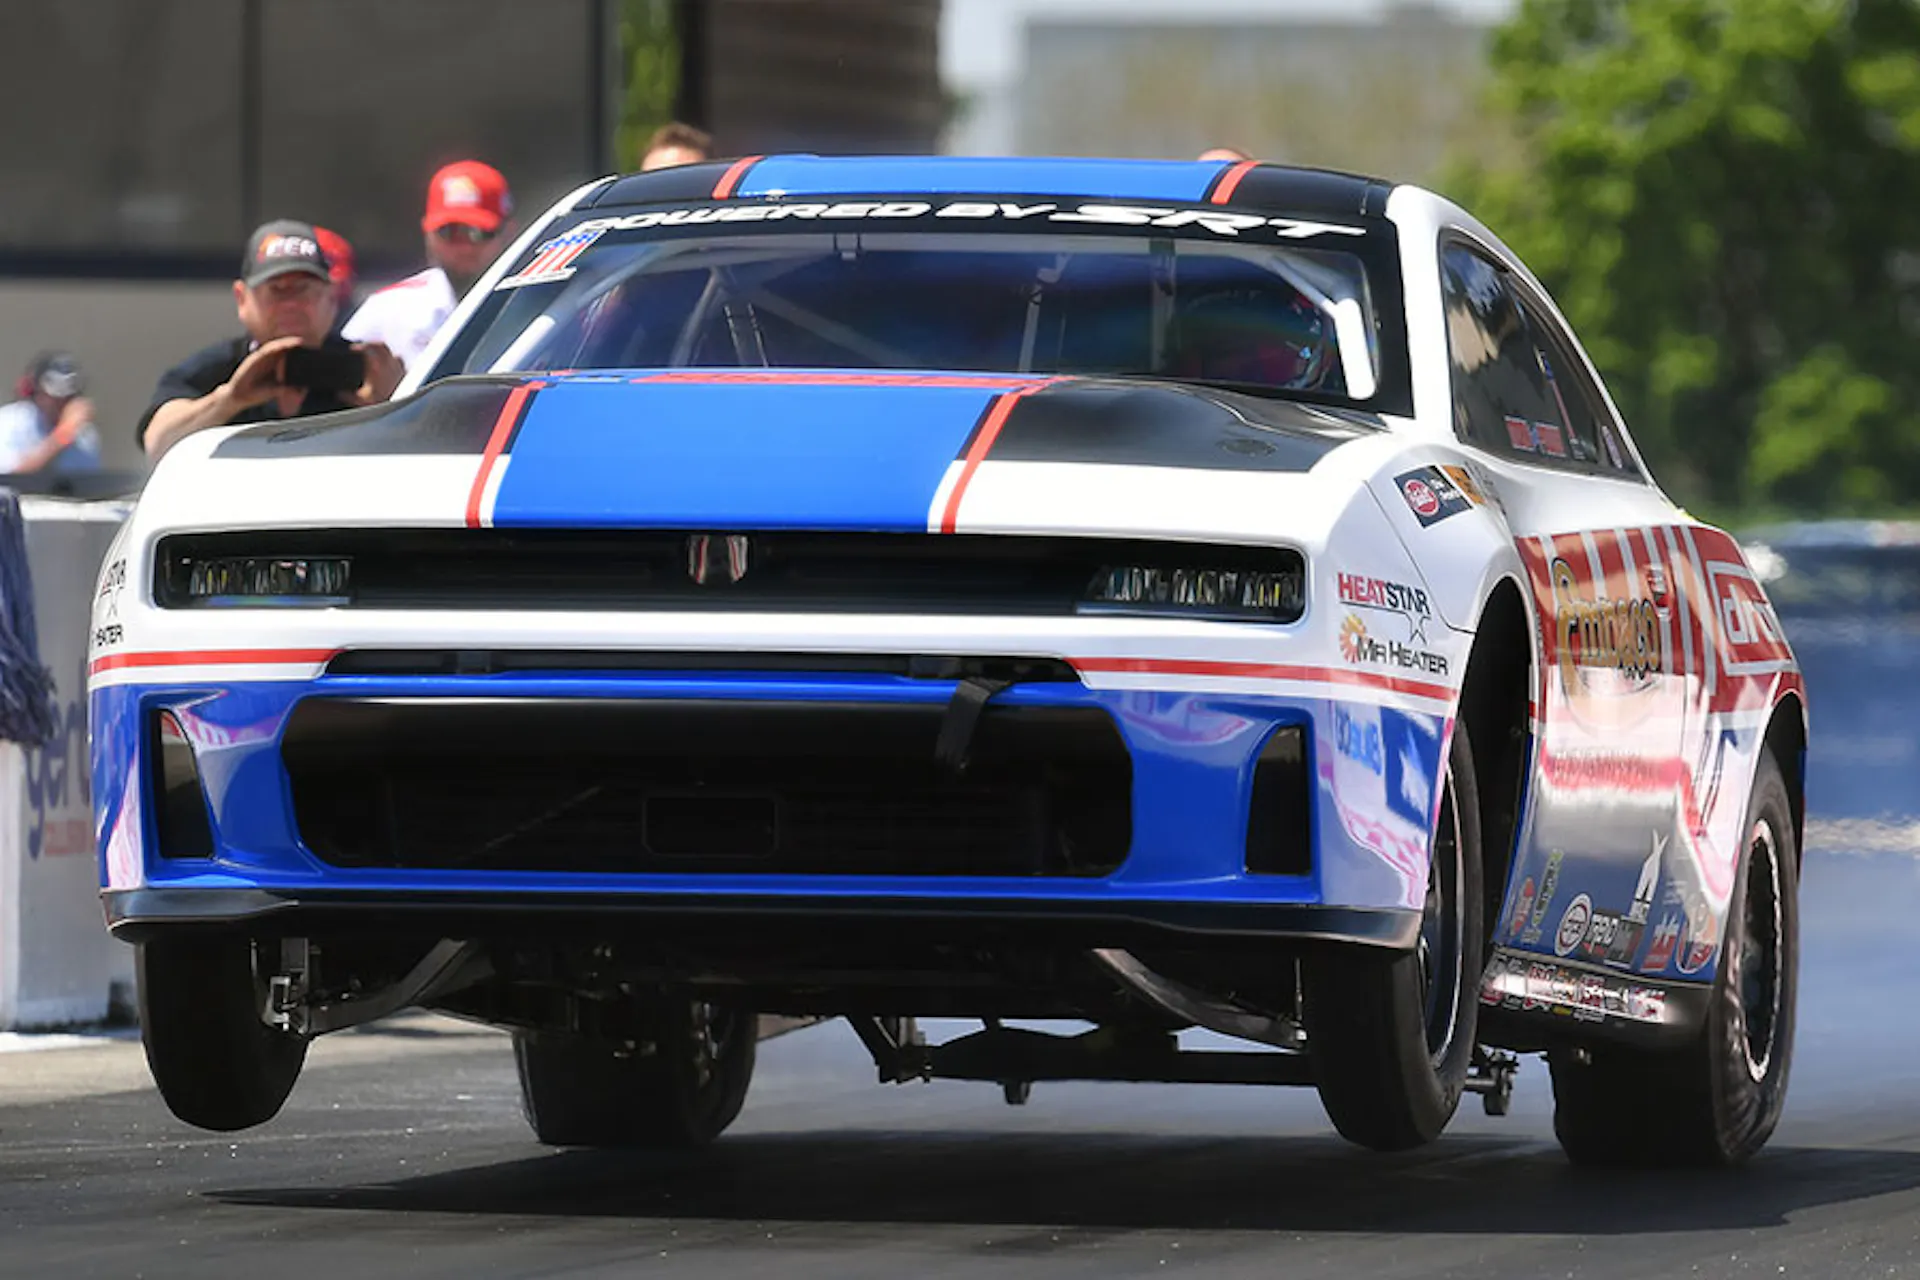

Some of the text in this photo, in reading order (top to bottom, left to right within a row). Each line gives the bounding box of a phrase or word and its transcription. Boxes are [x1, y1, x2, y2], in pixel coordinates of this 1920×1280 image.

[578, 203, 1367, 239] POWERED BY SRT
[1337, 571, 1431, 615] HEATSTAR
